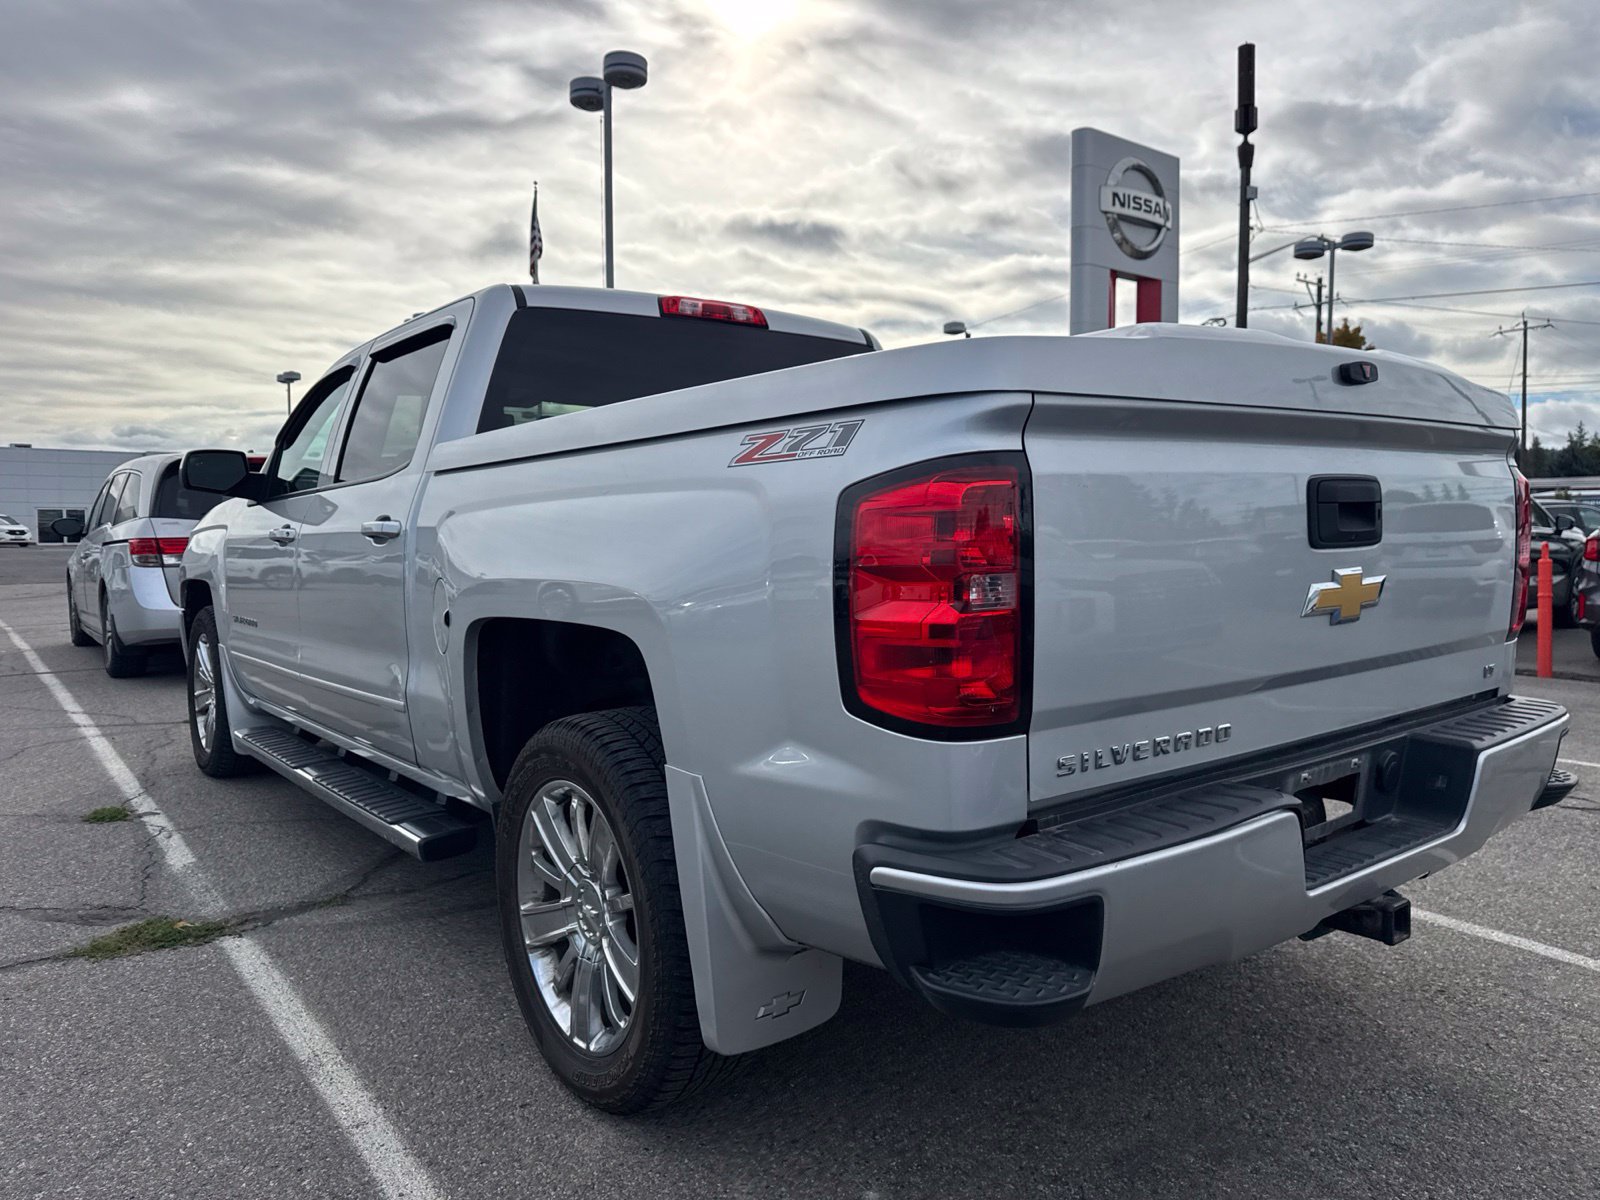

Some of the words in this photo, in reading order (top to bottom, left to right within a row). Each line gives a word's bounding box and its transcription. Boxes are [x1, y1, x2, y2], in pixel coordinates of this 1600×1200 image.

[728, 419, 865, 467] Z71
[797, 450, 816, 458] OFF
[817, 447, 845, 456] ROAD
[1056, 723, 1232, 777] SILVERADO
